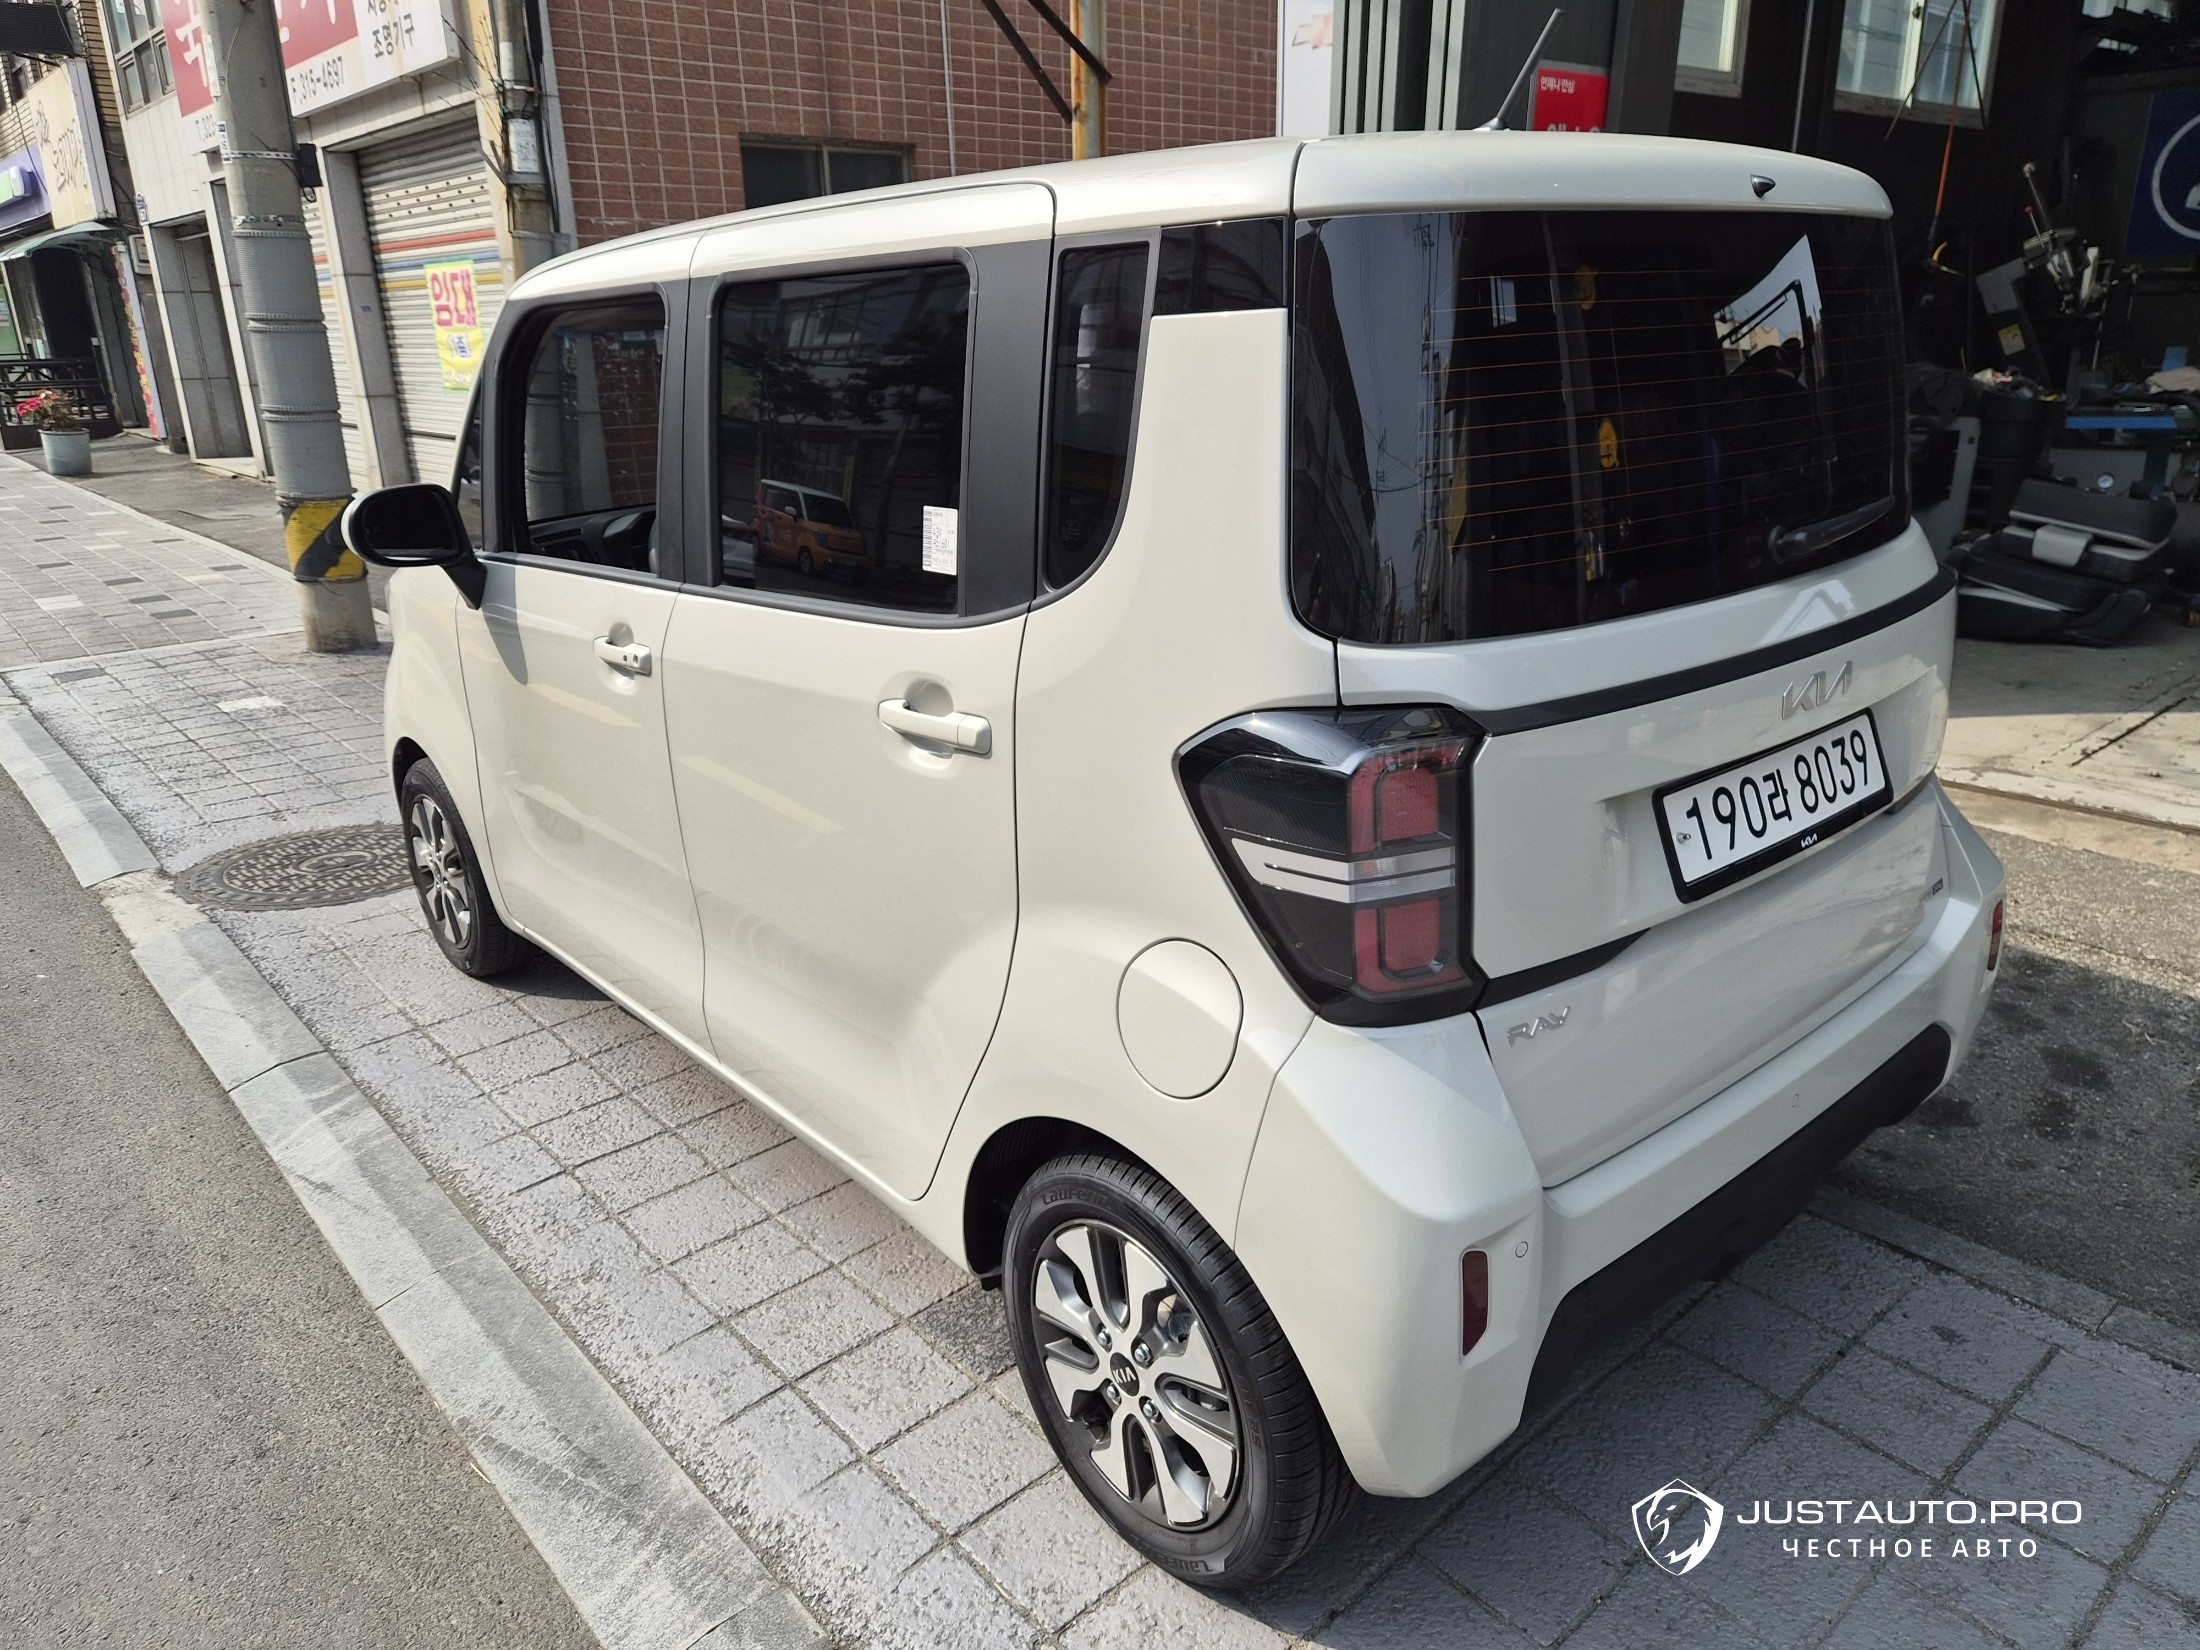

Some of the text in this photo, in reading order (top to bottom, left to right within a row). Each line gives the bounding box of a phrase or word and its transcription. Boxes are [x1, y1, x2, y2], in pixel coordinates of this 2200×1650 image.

[372, 13, 415, 59] 조명기구
[291, 56, 345, 105] F.315-4697
[431, 269, 476, 327] 임대
[1686, 729, 1869, 861] 190라 8039
[1507, 1006, 1570, 1047] RAY
[1112, 1366, 1138, 1385] KIA
